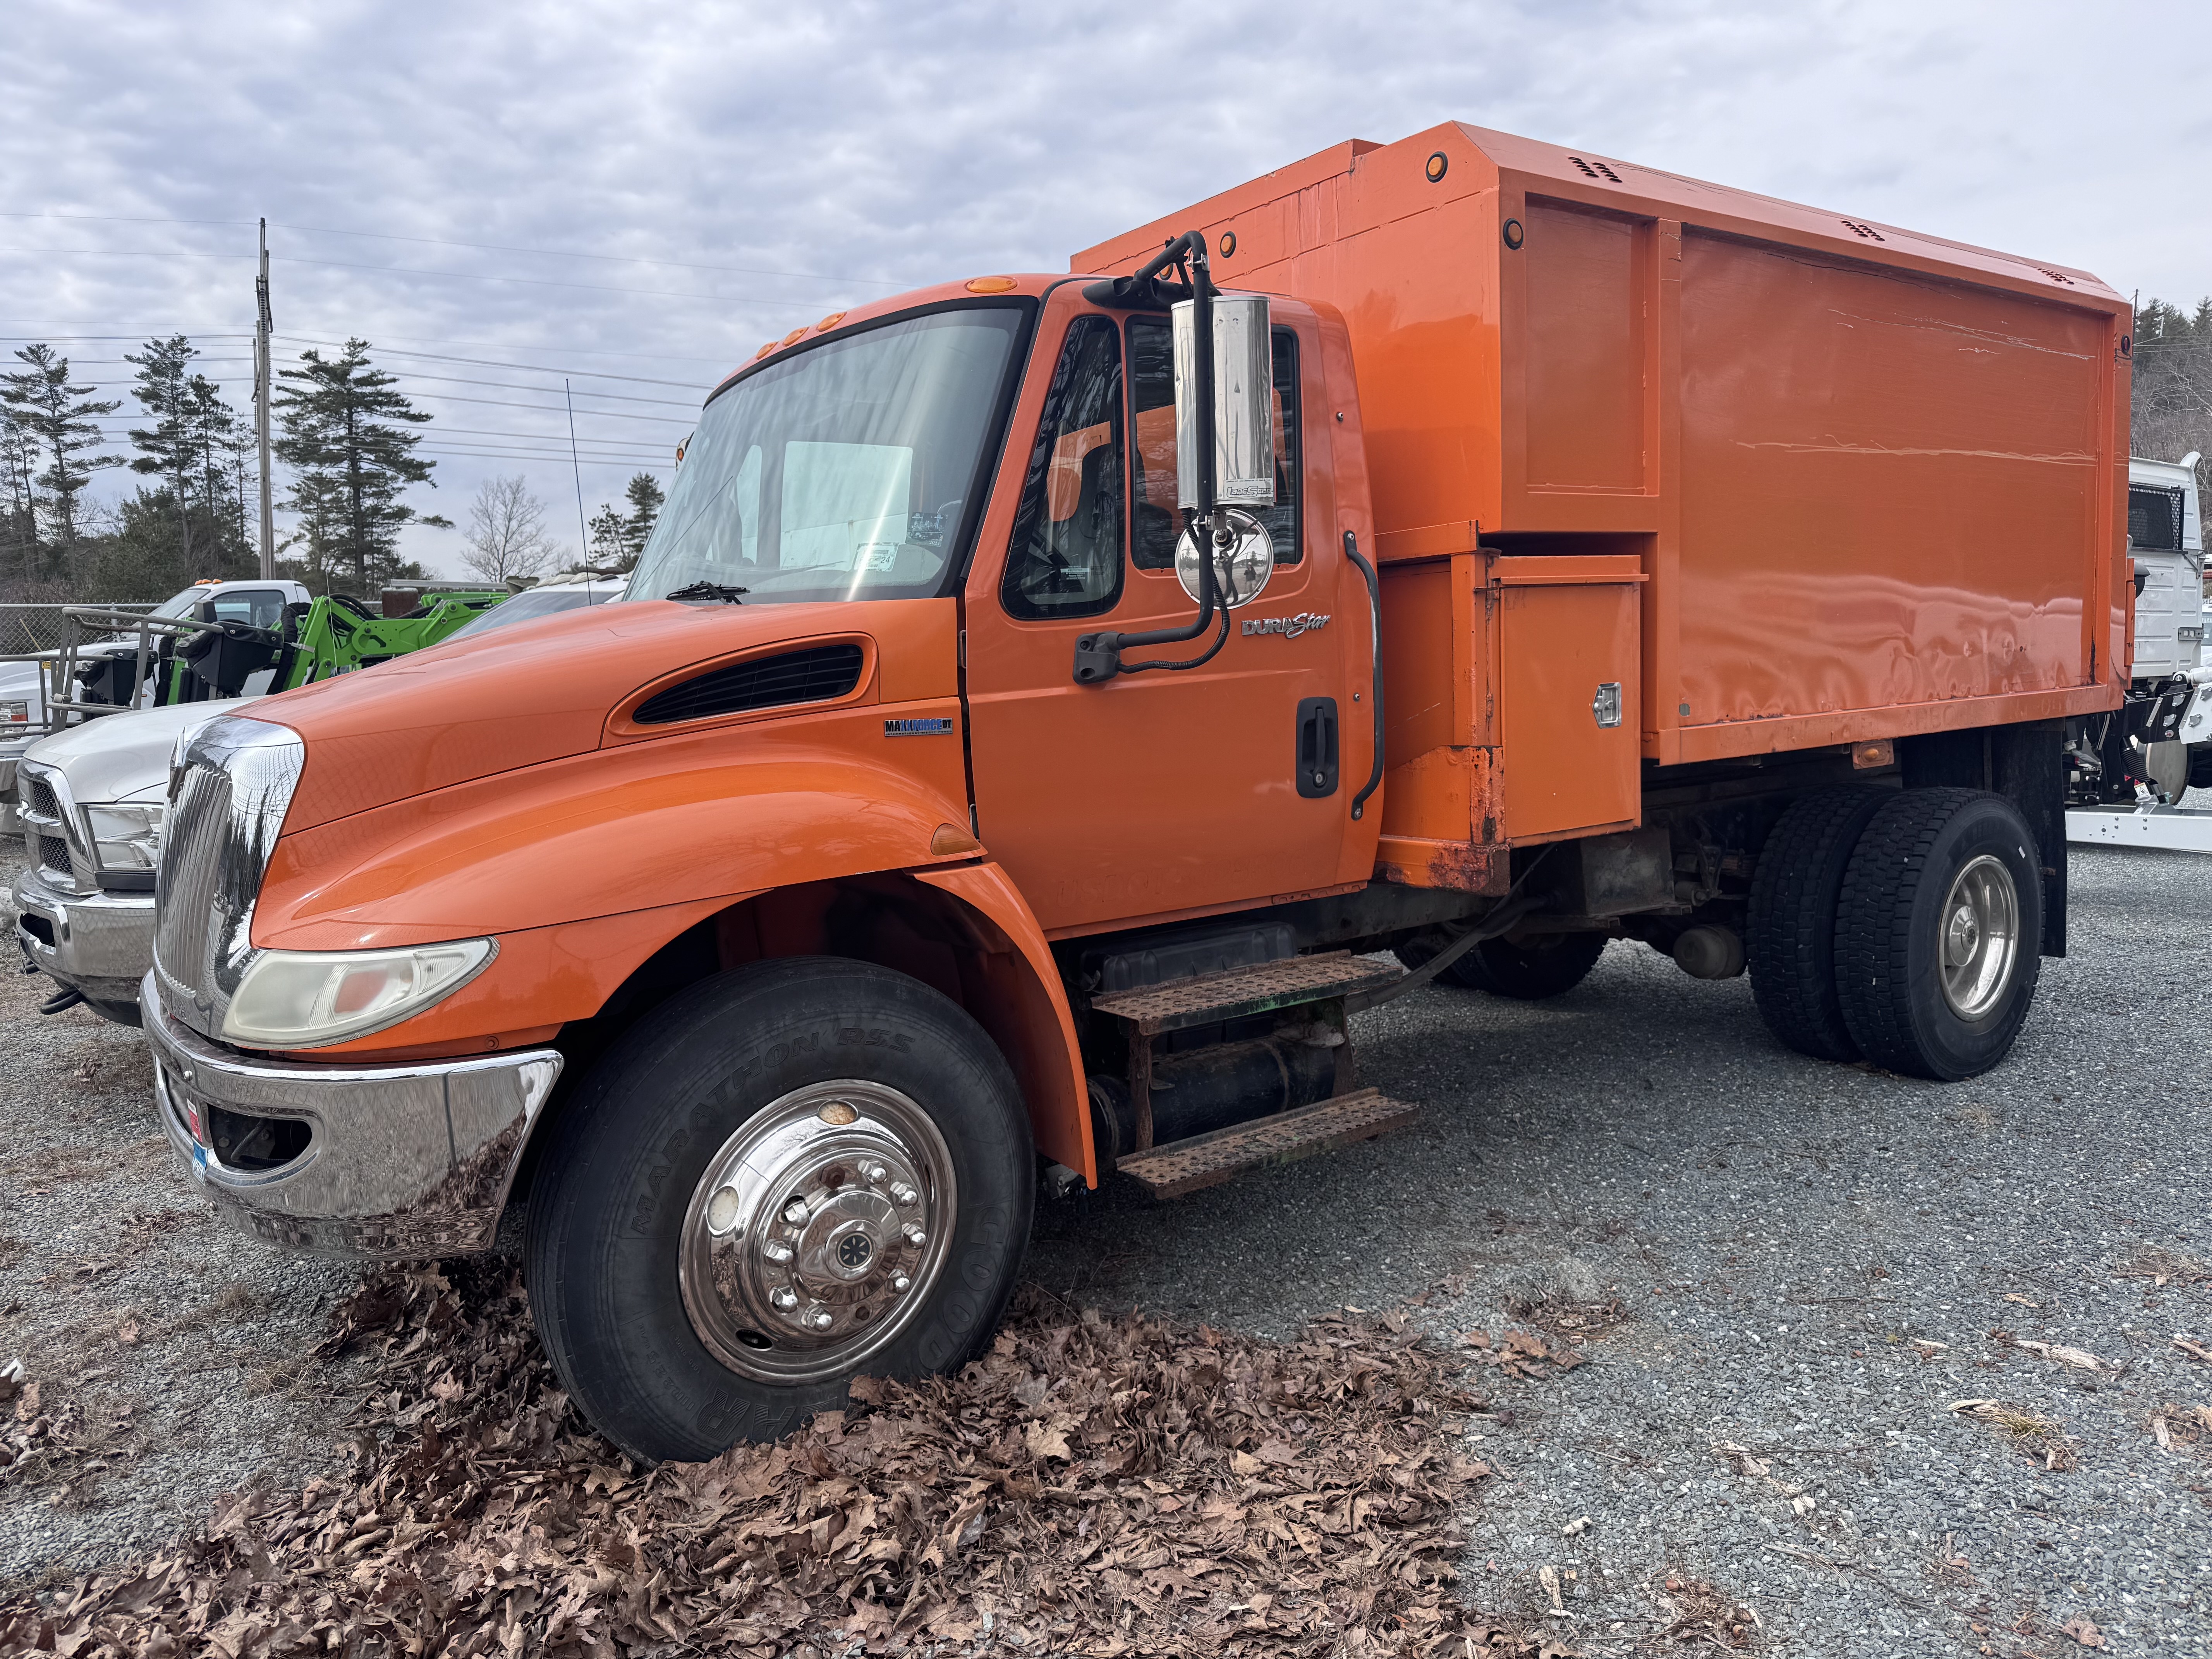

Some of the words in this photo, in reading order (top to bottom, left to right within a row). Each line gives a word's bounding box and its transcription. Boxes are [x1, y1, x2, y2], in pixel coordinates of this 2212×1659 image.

[1226, 486, 1271, 498] LaneScan
[942, 720, 952, 729] DT
[916, 1091, 939, 1114] TUBELESS
[630, 1031, 818, 1234] MARATHON
[836, 1027, 915, 1054] RSS
[688, 1358, 701, 1374] LOAD
